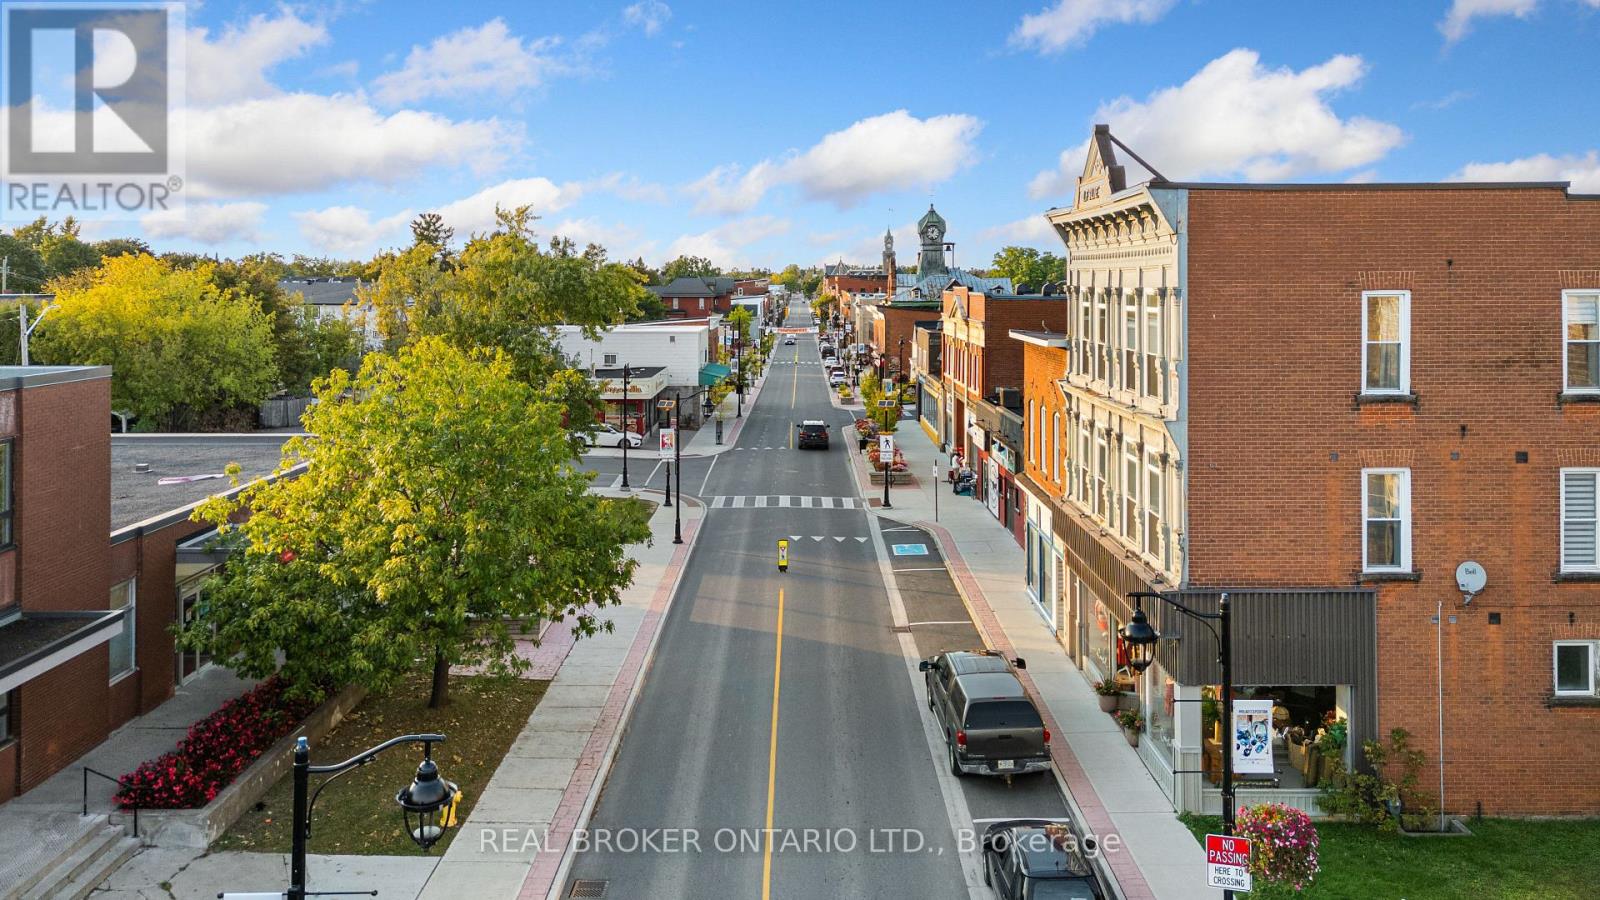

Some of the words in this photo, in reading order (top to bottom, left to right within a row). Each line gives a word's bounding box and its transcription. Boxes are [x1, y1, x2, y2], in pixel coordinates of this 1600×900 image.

[1464, 567, 1477, 575] Bell
[1222, 839, 1235, 851] NO
[1209, 849, 1248, 864] PASSING
[1214, 866, 1231, 875] HERE
[1235, 868, 1243, 877] TO
[1213, 876, 1245, 887] CROSSING
